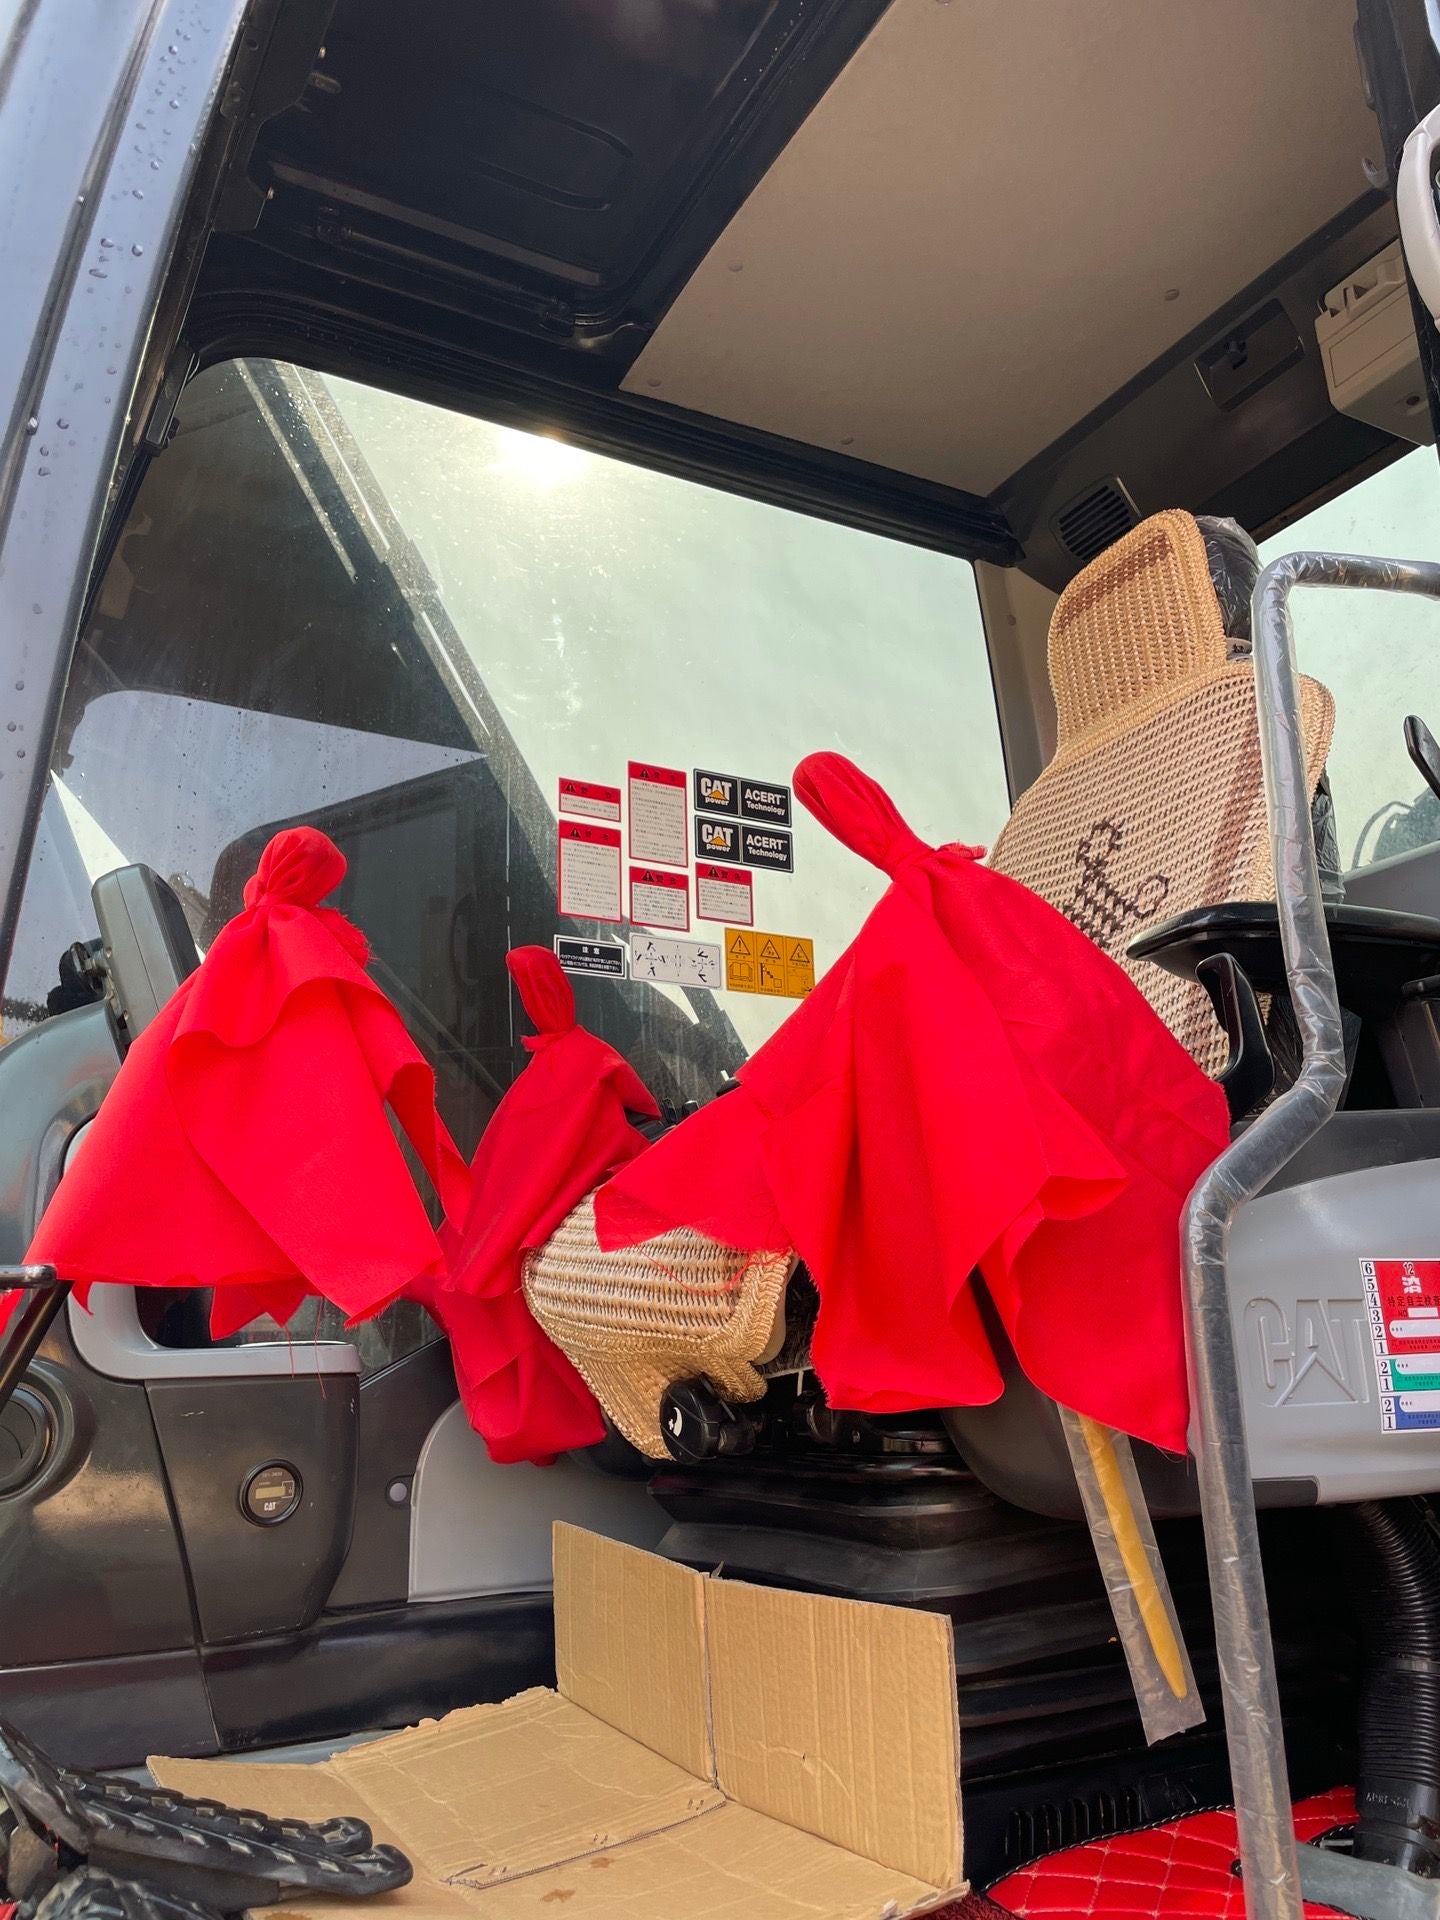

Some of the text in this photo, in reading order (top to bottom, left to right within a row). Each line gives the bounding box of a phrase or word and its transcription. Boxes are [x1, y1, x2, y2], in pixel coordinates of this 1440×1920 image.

[700, 777, 732, 801] CAT
[705, 797, 730, 806] power
[746, 800, 786, 816] Technology
[701, 823, 733, 847] CAT
[706, 843, 731, 853] power
[747, 846, 787, 862] Technology
[1364, 1262, 1373, 1275] 6
[1367, 1278, 1375, 1290] 5
[1369, 1293, 1377, 1306] 4
[1372, 1309, 1380, 1322] 3
[1375, 1325, 1383, 1338] 2
[1243, 1297, 1370, 1408] CAT
[1378, 1341, 1385, 1354] 1
[1381, 1361, 1388, 1374] 2
[1384, 1378, 1390, 1390] 1
[1384, 1399, 1392, 1412] 2
[1386, 1416, 1393, 1429] 1
[264, 1502, 276, 1511] CAT
